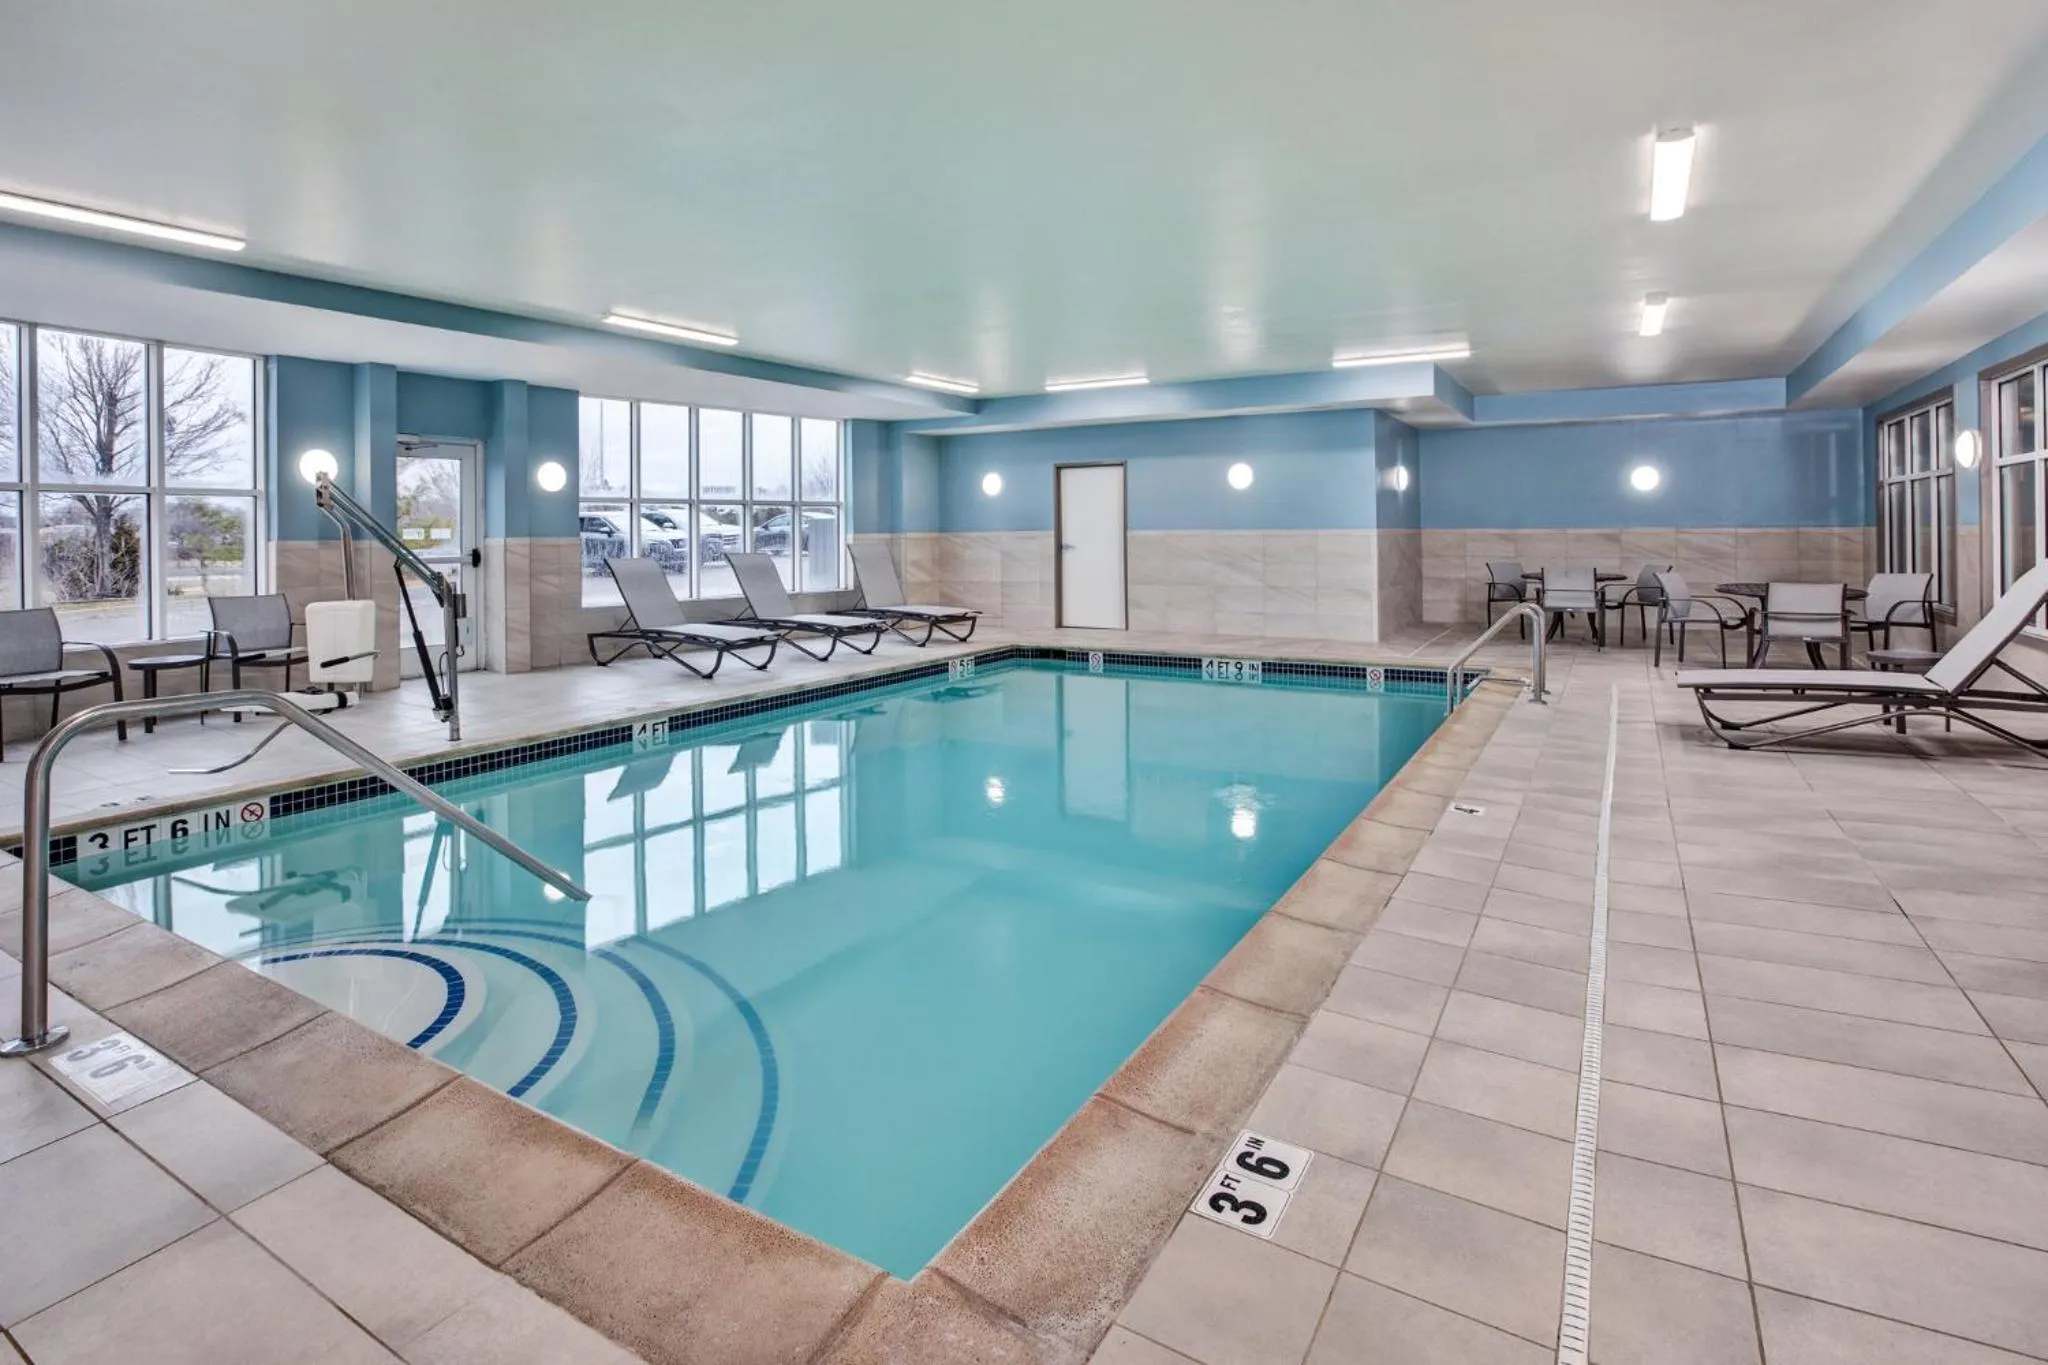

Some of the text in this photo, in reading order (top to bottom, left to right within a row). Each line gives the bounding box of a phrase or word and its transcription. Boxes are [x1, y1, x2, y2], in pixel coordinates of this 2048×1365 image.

[1218, 661, 1230, 672] FT
[652, 720, 667, 736] FT
[124, 824, 157, 850] FT
[171, 819, 189, 839] 6
[204, 809, 230, 832] IN
[89, 1054, 147, 1079] 6
[1208, 1136, 1290, 1225] 3 FT 6 IN
